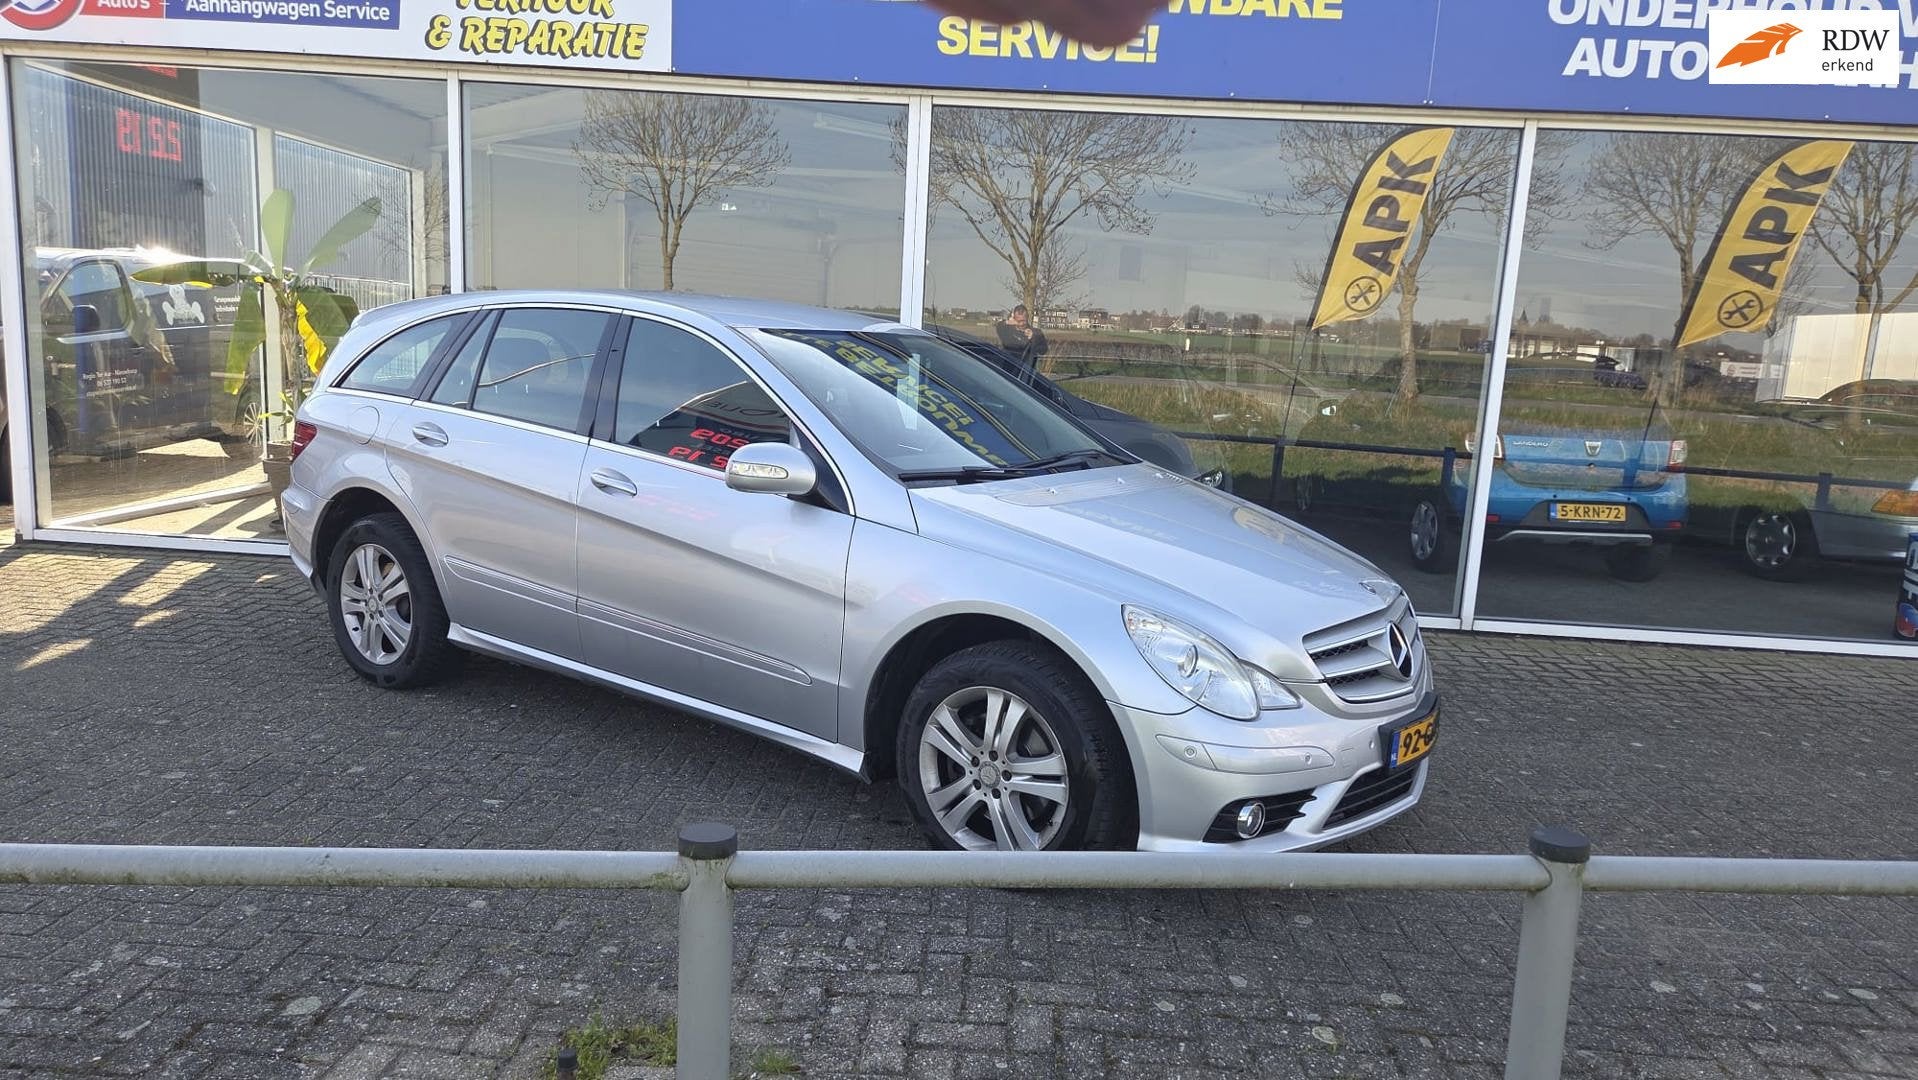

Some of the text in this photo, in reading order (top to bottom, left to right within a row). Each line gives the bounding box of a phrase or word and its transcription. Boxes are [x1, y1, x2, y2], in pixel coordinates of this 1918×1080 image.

[186, 0, 390, 21] Aanhangwagen Service
[425, 14, 649, 59] & REPARATIE
[1353, 150, 1437, 277] APK
[1728, 161, 1836, 291] APK
[1560, 505, 1622, 519] 5-KRN-72
